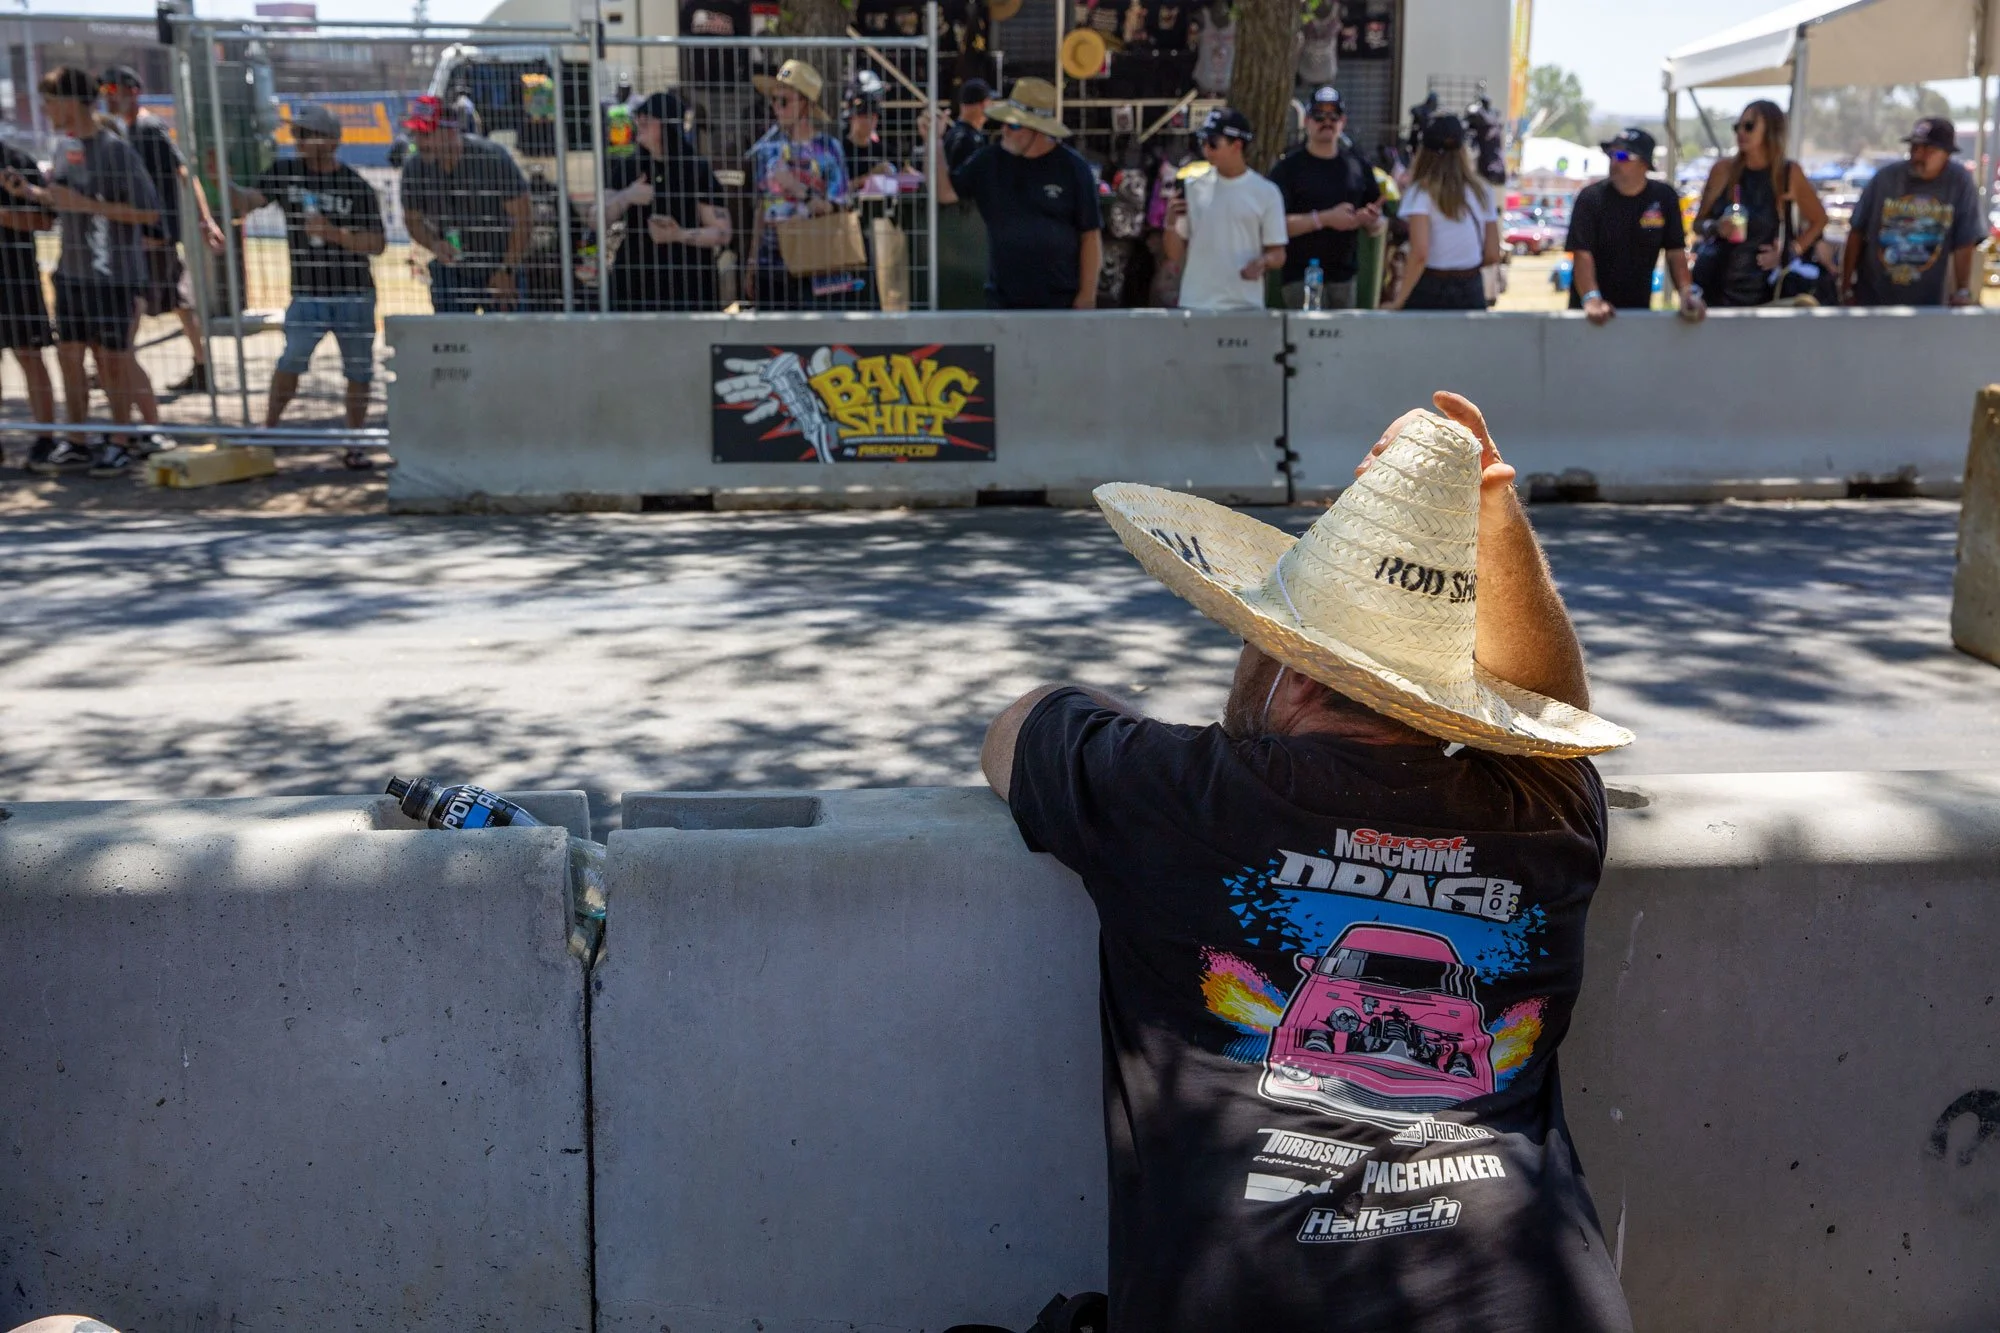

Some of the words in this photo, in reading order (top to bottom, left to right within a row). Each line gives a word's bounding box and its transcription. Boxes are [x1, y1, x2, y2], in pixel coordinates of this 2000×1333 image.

[809, 354, 980, 419] BANG
[836, 404, 952, 438] SHIFT
[1374, 556, 1446, 596] ROD
[1333, 828, 1475, 873] MACHINE
[1353, 828, 1467, 851] Street
[1257, 1128, 1376, 1167] TURBOSMA
[1361, 1154, 1506, 1194] PACEMAKER
[1301, 1233, 1338, 1241] ENGINE
[1342, 1225, 1409, 1239] MANAGEMENT
[1411, 1217, 1455, 1230] SYSTEMS
[1304, 1199, 1458, 1234] Haltech
